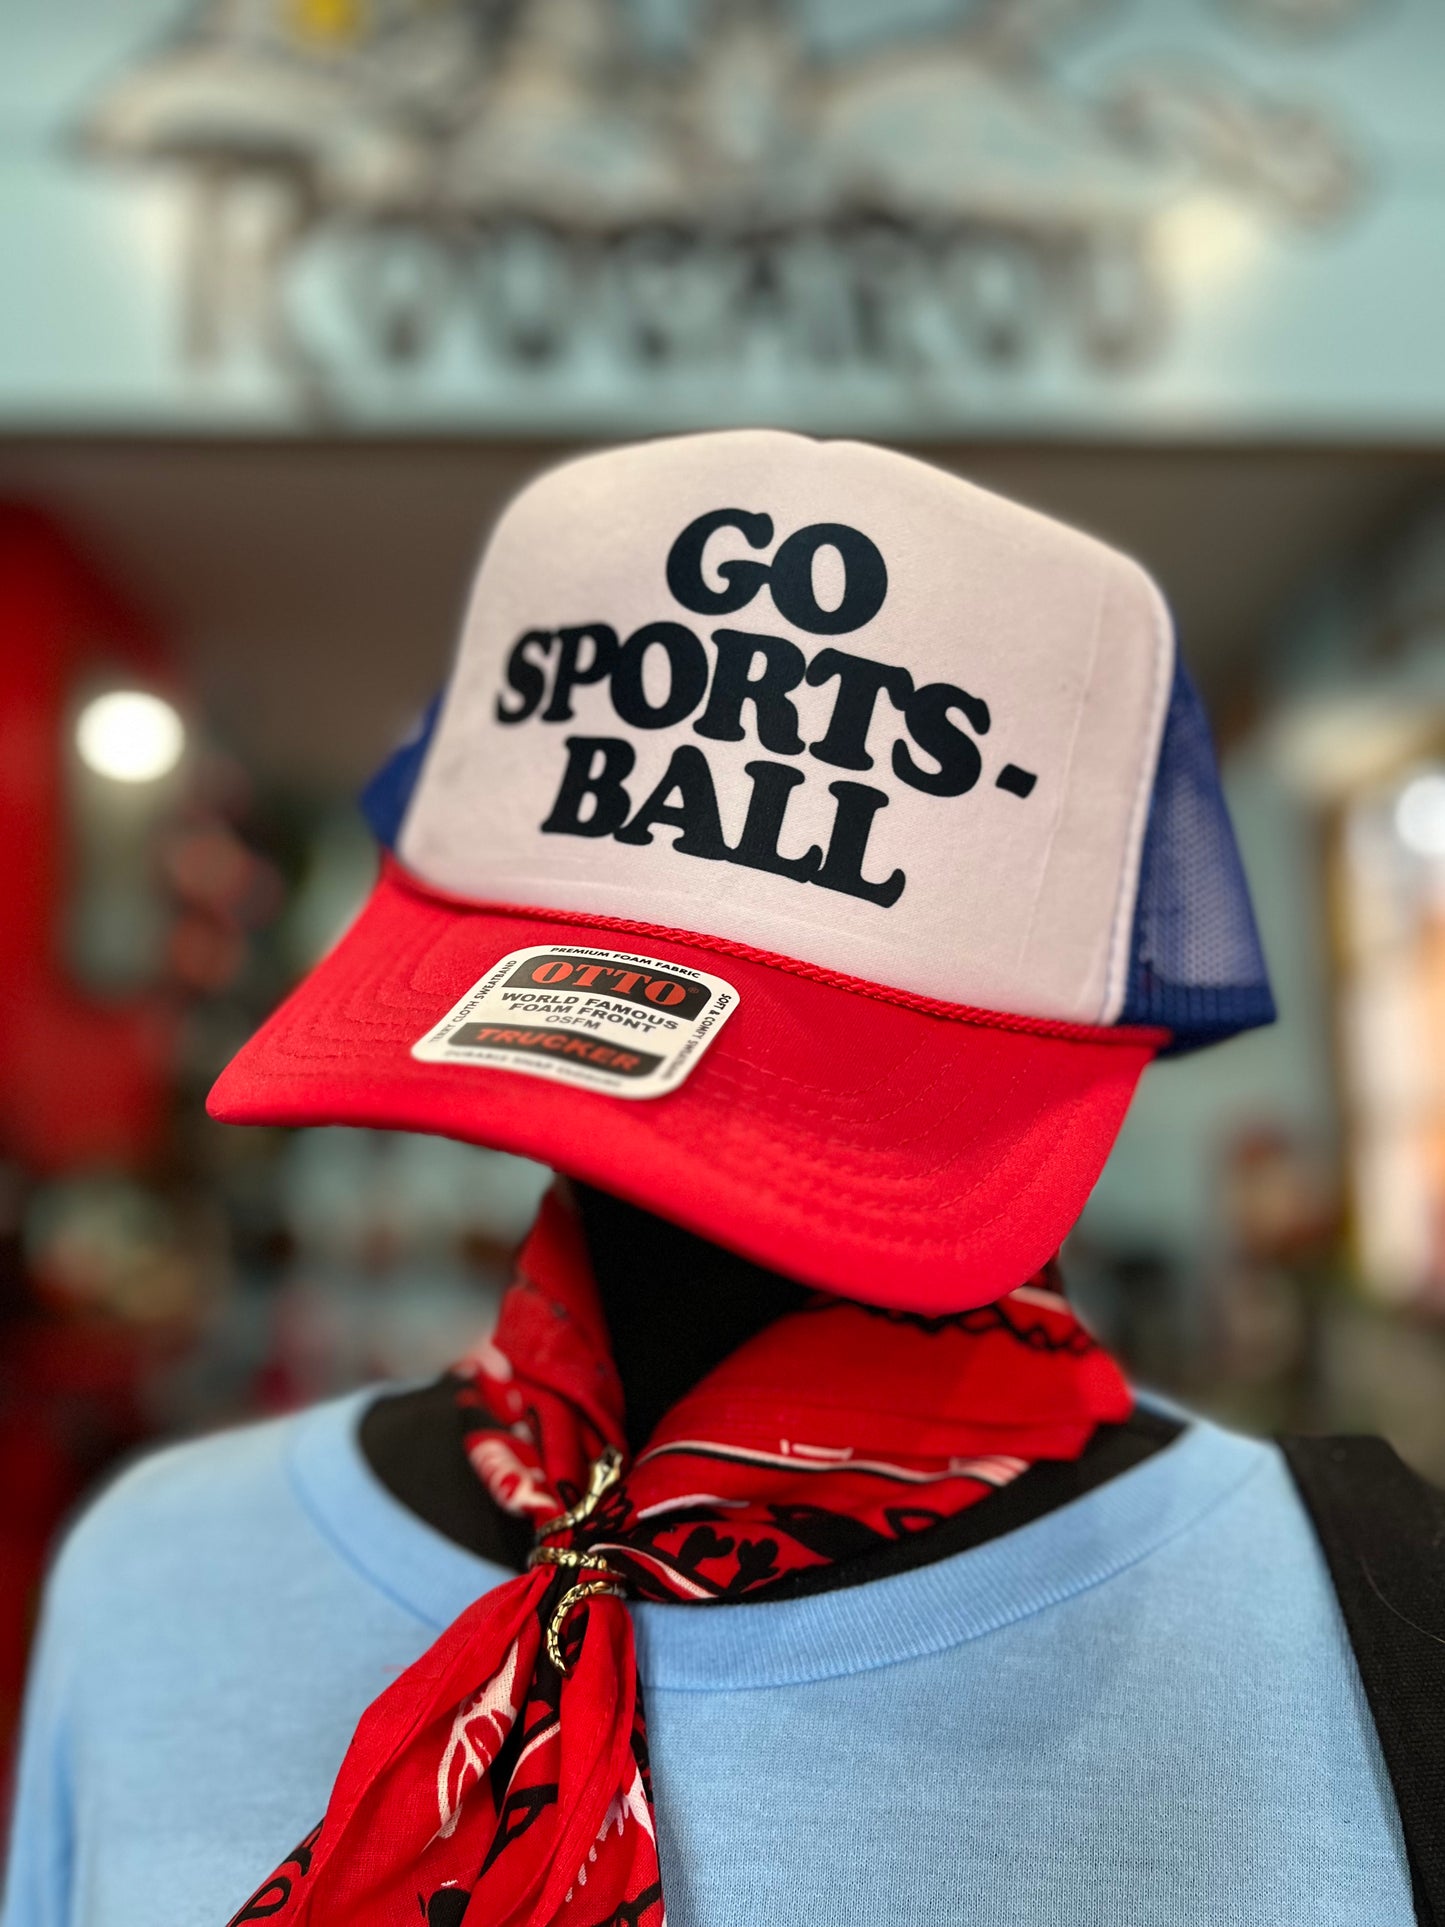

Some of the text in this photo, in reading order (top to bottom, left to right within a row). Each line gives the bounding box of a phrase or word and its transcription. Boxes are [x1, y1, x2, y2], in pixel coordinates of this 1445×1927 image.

[666, 508, 888, 635] GO
[541, 736, 906, 908] BALL
[550, 947, 701, 979] PREMIUM FOAM FABRIC
[452, 1000, 480, 1022] CLOTH
[474, 960, 518, 999] SWEATBAND
[531, 961, 687, 1006] OTTO
[713, 993, 732, 1010] SOFT
[501, 992, 679, 1030] WORLD FAMOUS
[508, 1003, 656, 1034] FOAM FRONT
[545, 1014, 602, 1031] OSFM
[692, 1016, 716, 1040] COMFY
[475, 1027, 642, 1072] TRUCKER
